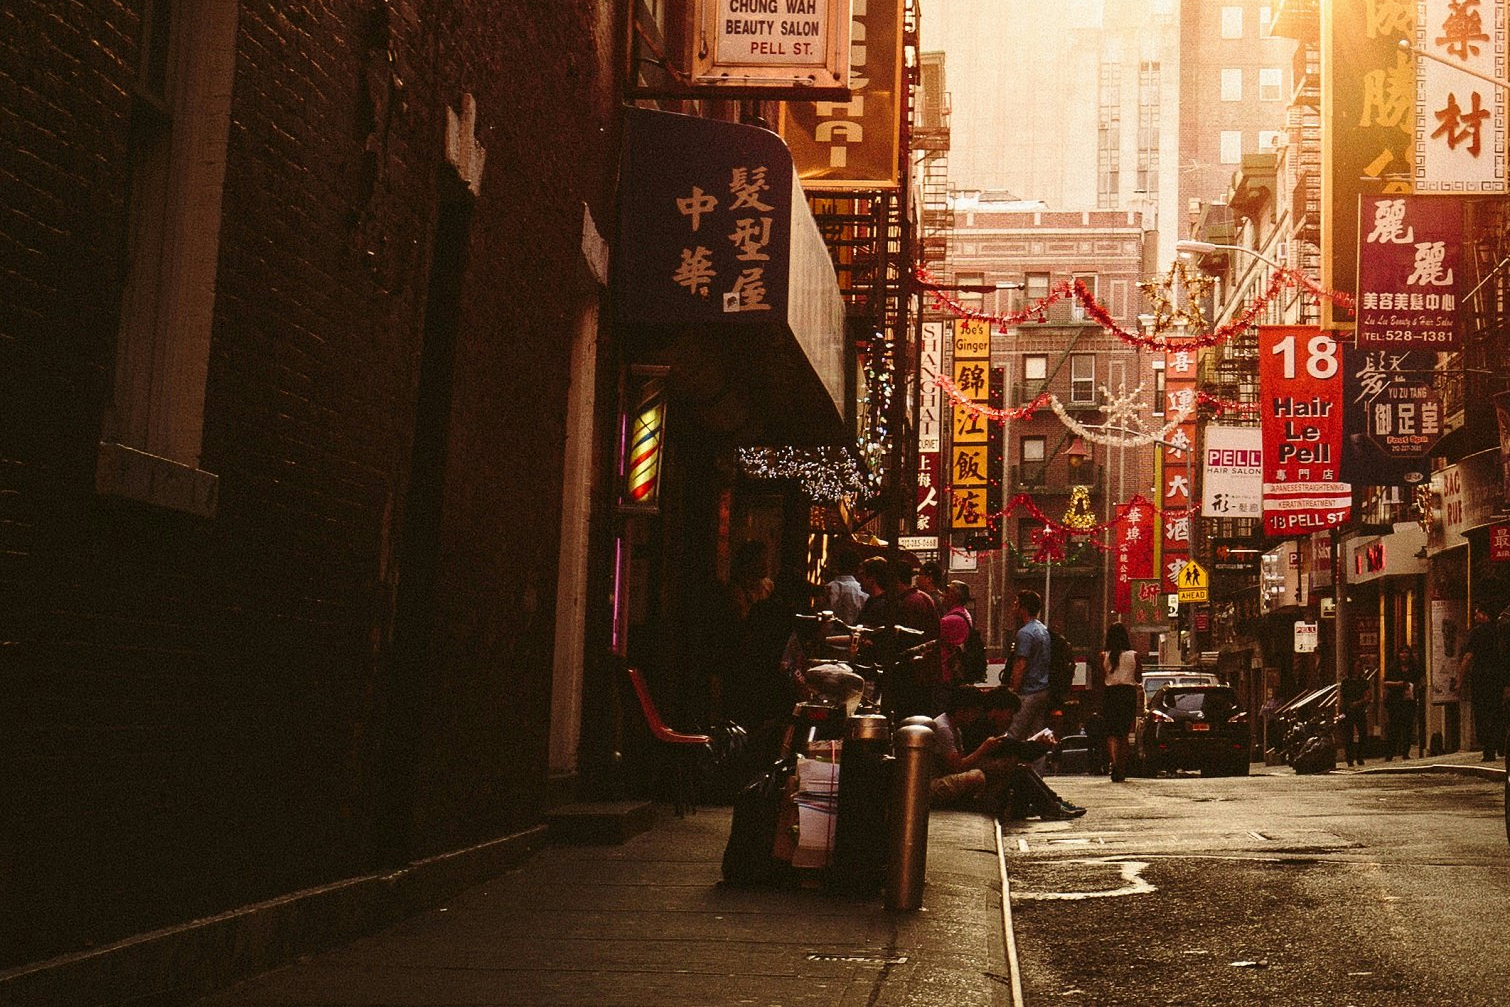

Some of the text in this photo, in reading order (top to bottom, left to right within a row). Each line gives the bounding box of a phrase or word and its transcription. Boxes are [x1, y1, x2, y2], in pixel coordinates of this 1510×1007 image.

[786, 0, 816, 14] WAH
[725, 19, 819, 36] BEAUTY SALON
[750, 42, 813, 55] PELL ST.
[672, 186, 719, 298] 中華
[728, 166, 775, 312] 髮型屋
[1364, 292, 1456, 311] 美容美髮中心
[961, 324, 983, 336] Joe's
[956, 339, 988, 353] Ginger
[1272, 335, 1338, 379] 18
[1410, 387, 1427, 398] TANG
[1274, 397, 1333, 418] Hair
[1375, 402, 1439, 435] 御足堂
[1285, 421, 1321, 441] Le
[954, 363, 988, 525] 錦江飯店
[1208, 450, 1261, 466] PELL
[1279, 443, 1331, 464] Pell
[1276, 469, 1334, 481] 專門店
[1289, 513, 1325, 528] PELL
[1326, 511, 1346, 524] ST
[1181, 591, 1205, 599] AHEAD
